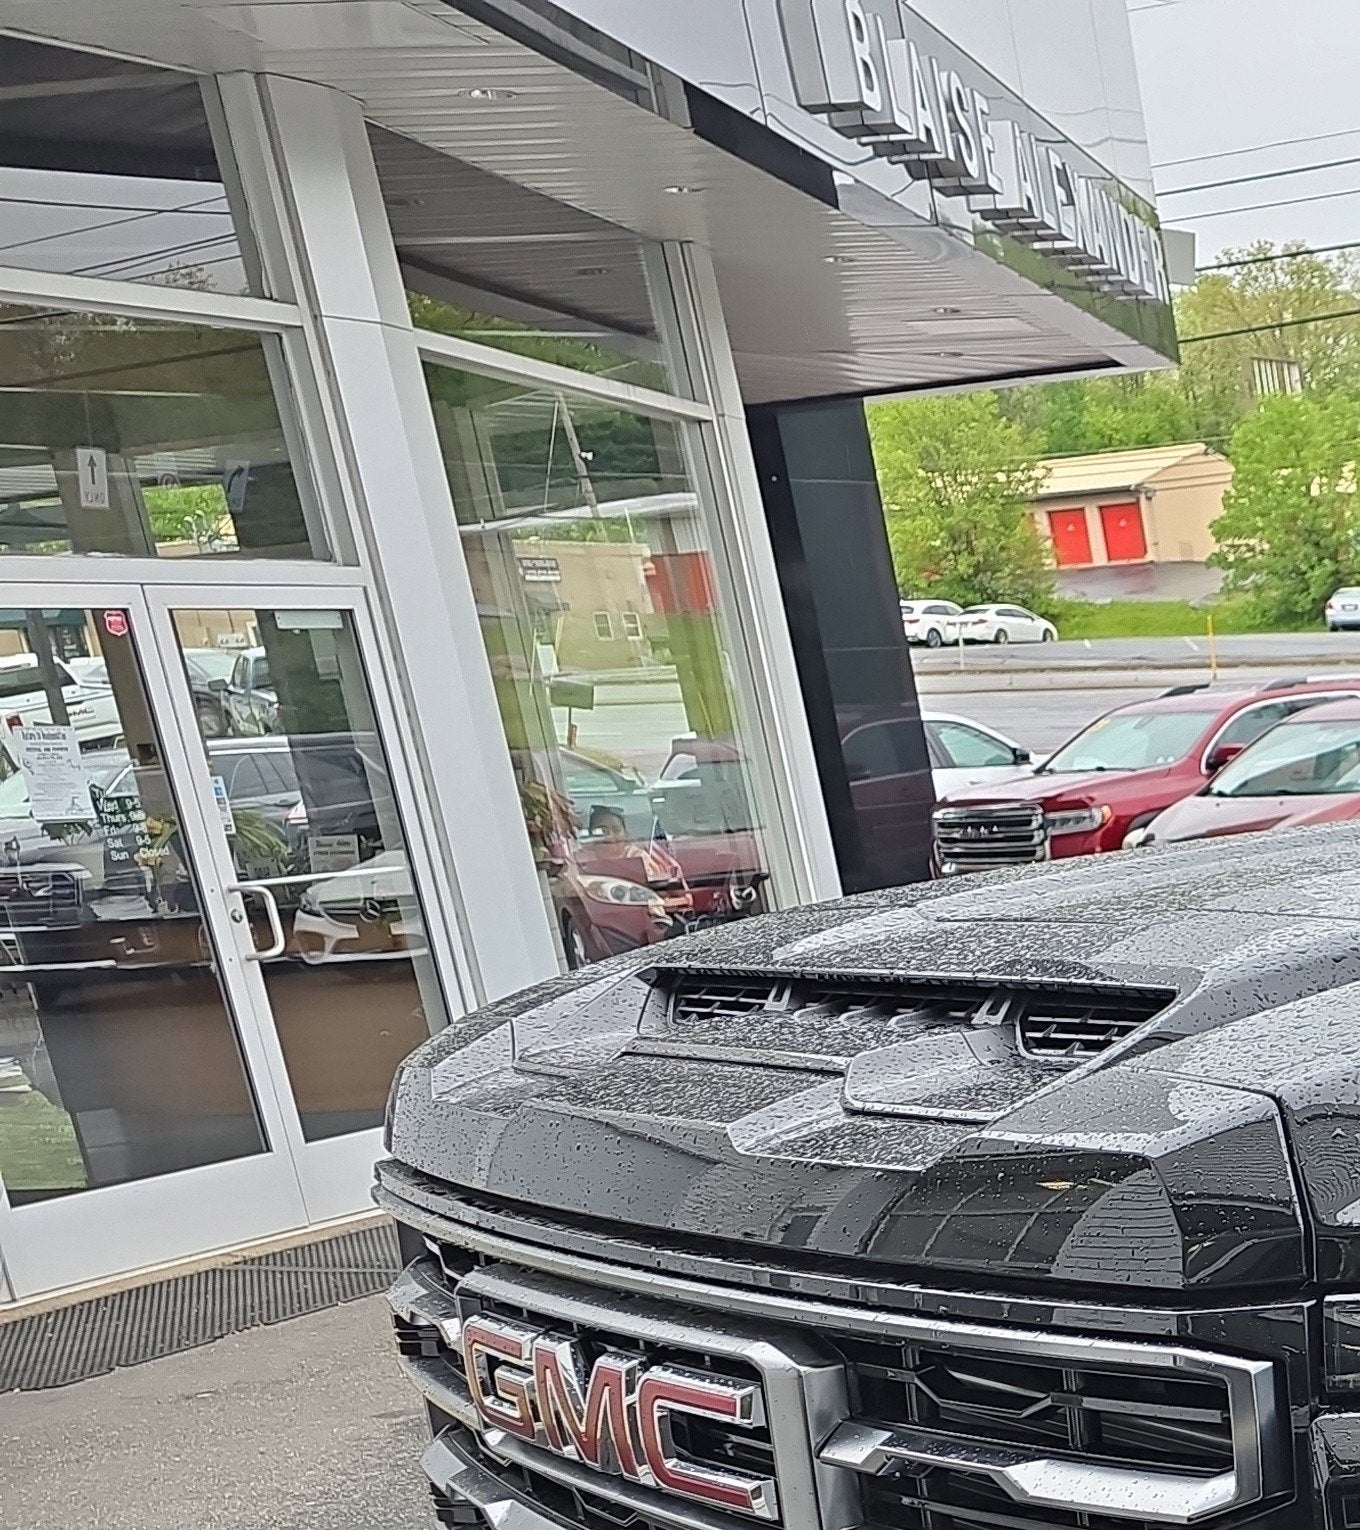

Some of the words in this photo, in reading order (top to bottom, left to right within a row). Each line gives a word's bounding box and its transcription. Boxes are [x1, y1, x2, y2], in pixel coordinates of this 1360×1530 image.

[843, 0, 1004, 195] BLAISE
[1012, 120, 1171, 306] ALEXANDER
[109, 850, 130, 861] Sun
[462, 1311, 781, 1521] GMC
